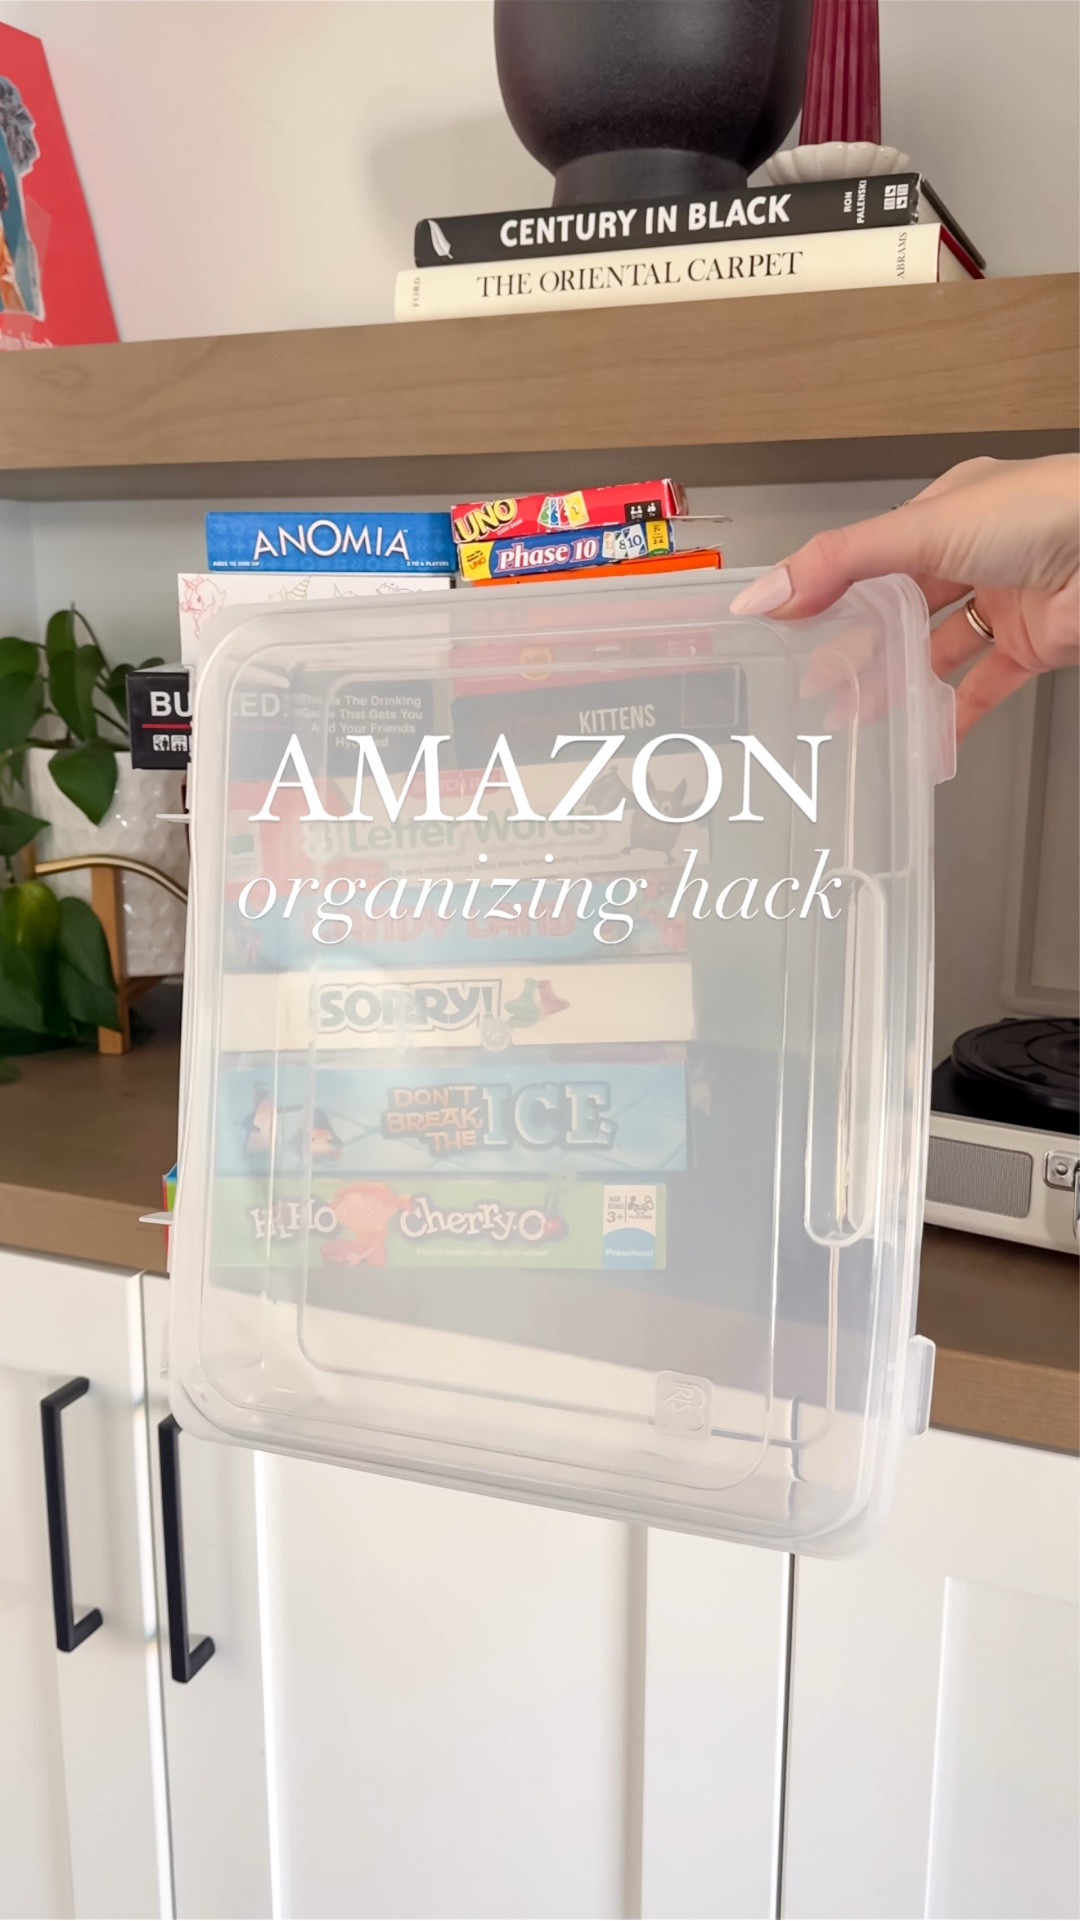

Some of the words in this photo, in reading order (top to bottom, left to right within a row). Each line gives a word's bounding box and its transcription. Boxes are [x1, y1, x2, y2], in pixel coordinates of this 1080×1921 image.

[843, 191, 853, 213] RON
[856, 180, 867, 224] PALENSKI
[499, 209, 638, 248] CENTURY
[645, 203, 677, 234] IN
[687, 193, 792, 231] BLACK
[896, 231, 907, 279] ABRAMS
[476, 273, 533, 298] THE
[538, 259, 680, 294] ORIENTAL
[687, 250, 803, 283] CARPET
[454, 498, 516, 540] UNO
[253, 519, 409, 561] ANOMIA
[500, 543, 568, 570] Phase
[573, 540, 599, 562] 10
[339, 709, 365, 719] That
[368, 709, 397, 720] Gets
[400, 710, 423, 720] You
[345, 696, 367, 706] The
[370, 695, 422, 708] Drinking
[339, 723, 366, 733] Your
[370, 723, 416, 733] Friends
[579, 704, 656, 735] KITTENS
[349, 818, 458, 852] Letter
[474, 808, 597, 843] Words
[319, 986, 493, 1029] SORRY!
[394, 1085, 477, 1108] DON'T
[386, 1106, 485, 1134] BREAK
[483, 1084, 611, 1146] ICE
[426, 1130, 477, 1152] THE
[607, 1211, 624, 1223] 3+
[604, 1247, 655, 1257] Preschool
